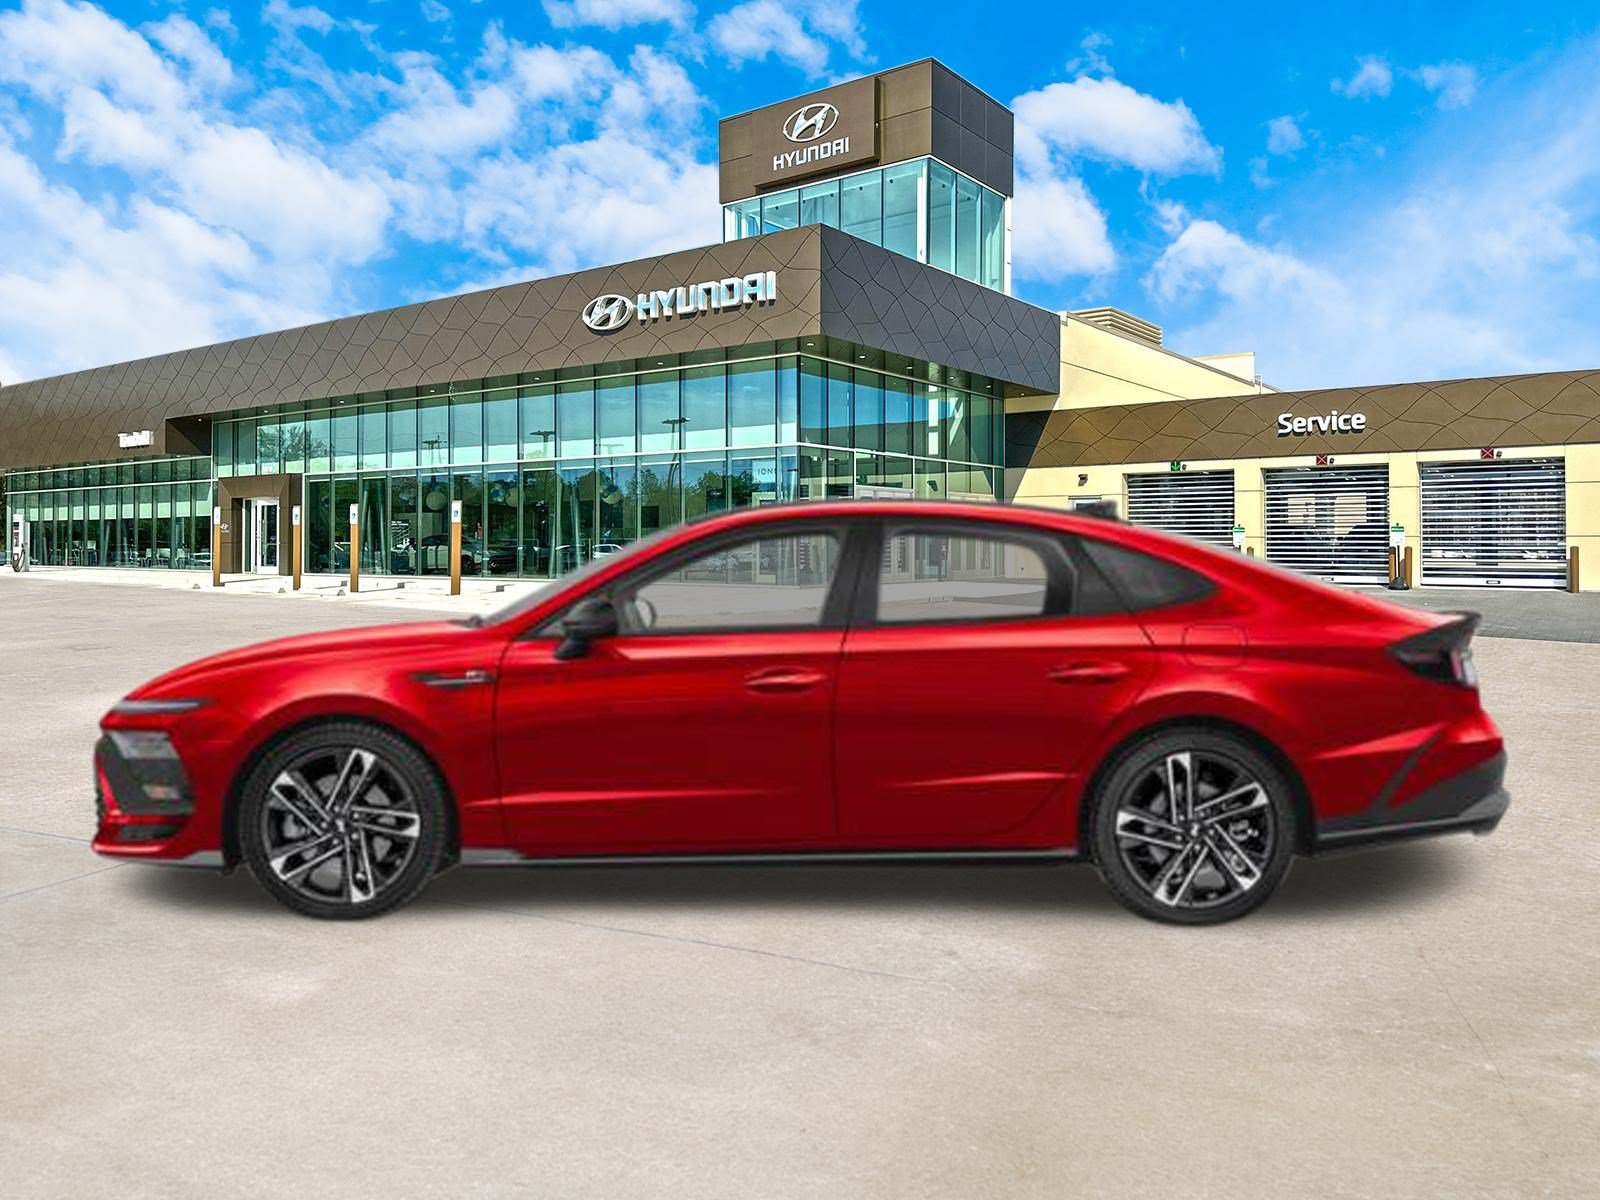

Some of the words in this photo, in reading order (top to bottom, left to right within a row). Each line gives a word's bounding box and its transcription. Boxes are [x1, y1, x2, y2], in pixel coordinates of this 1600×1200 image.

[773, 136, 850, 171] HYUNDAI
[636, 270, 777, 321] HYUNDAI
[1277, 410, 1367, 434] Service
